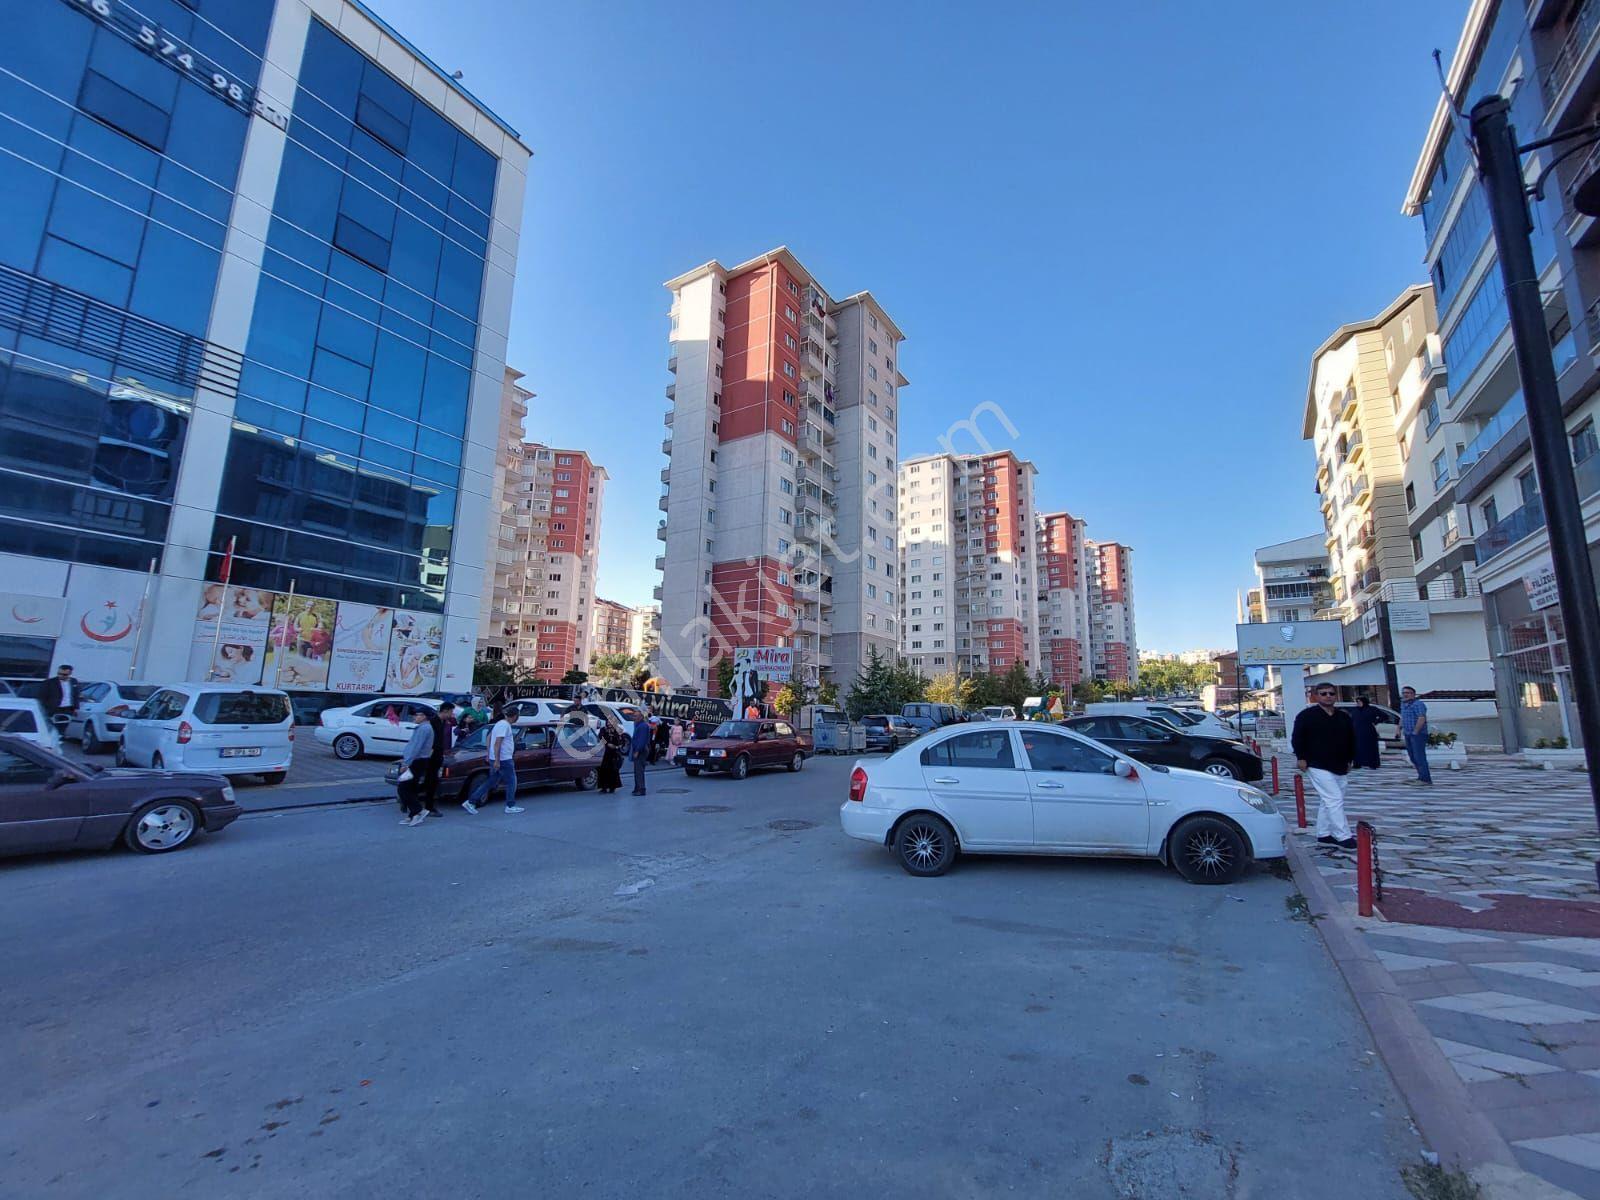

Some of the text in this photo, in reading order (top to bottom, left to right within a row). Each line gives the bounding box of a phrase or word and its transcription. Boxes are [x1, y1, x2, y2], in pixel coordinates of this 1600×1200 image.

[138, 25, 194, 70] 574
[212, 73, 244, 101] 98
[754, 649, 790, 663] Mira
[516, 685, 560, 697] Yeni Mira
[649, 694, 690, 720] Mira
